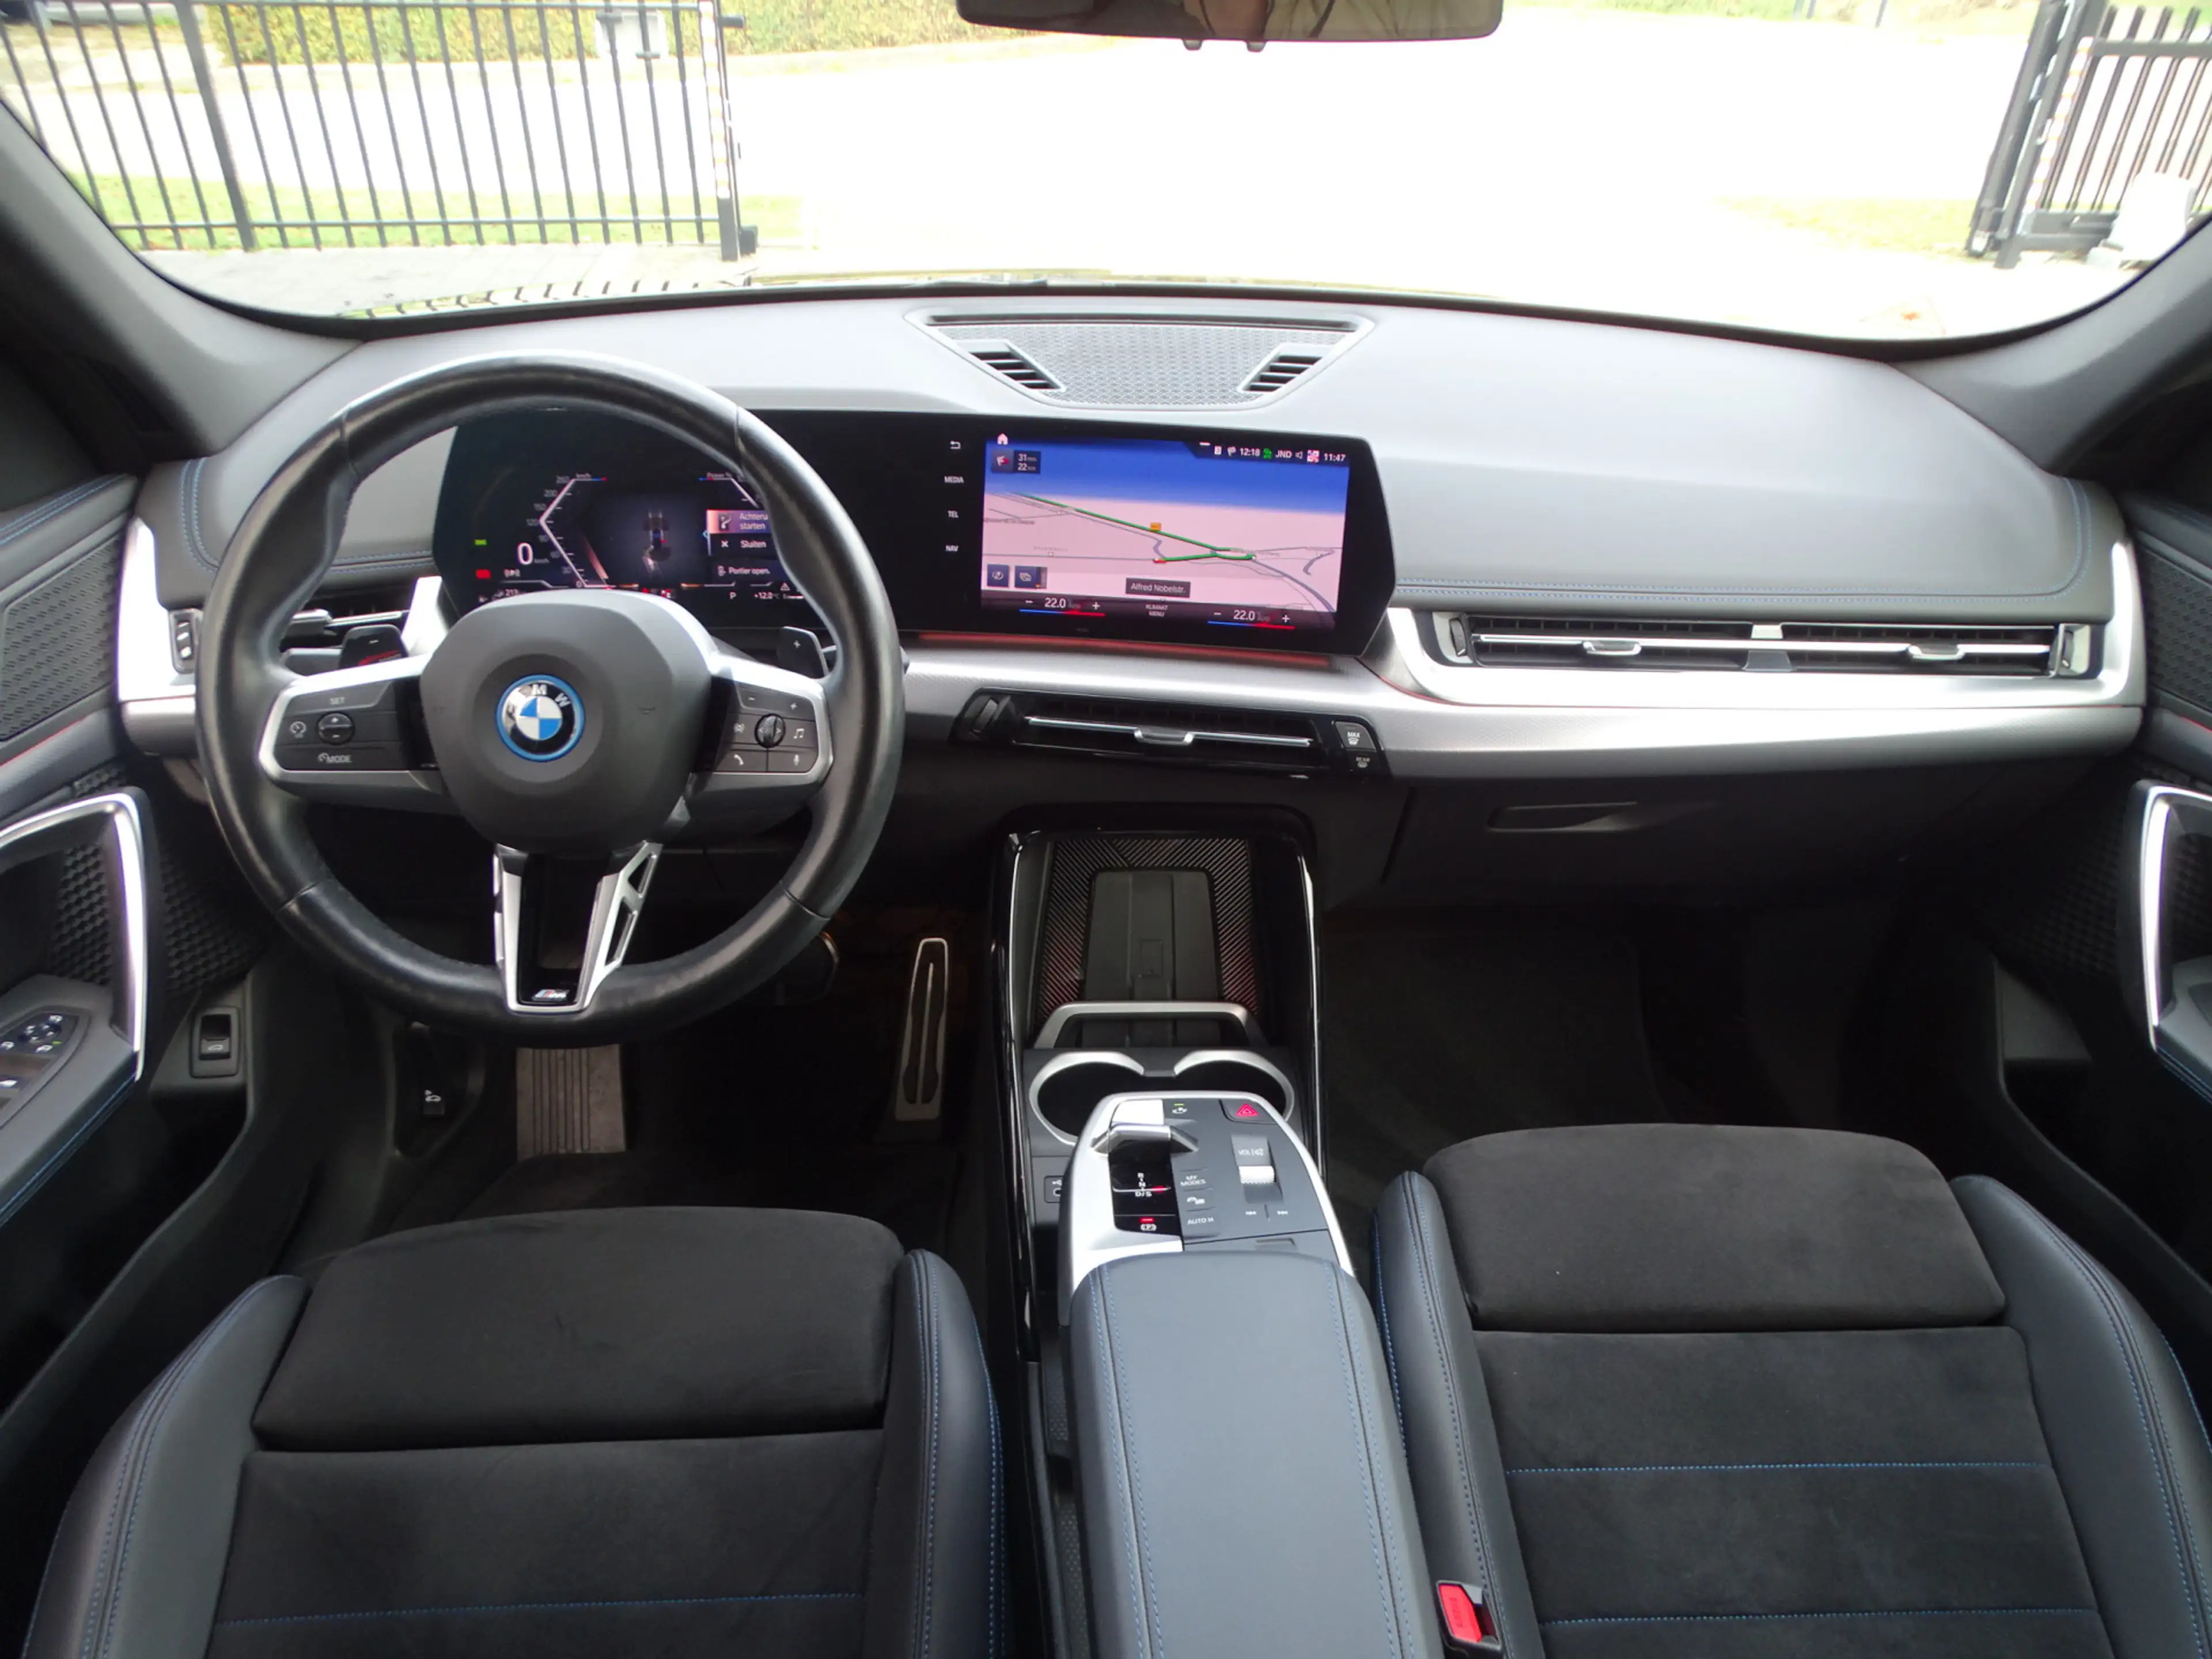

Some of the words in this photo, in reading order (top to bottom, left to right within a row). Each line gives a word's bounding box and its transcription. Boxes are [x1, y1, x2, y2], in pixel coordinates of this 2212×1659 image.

[1018, 453, 1027, 461] 31
[948, 510, 959, 518] TEL
[945, 544, 959, 552] NAV
[517, 542, 533, 565] 0
[1131, 582, 1153, 591] Alfred
[1154, 584, 1185, 593] Nobelstr.
[1044, 597, 1066, 608] 22.0
[1233, 609, 1255, 620] 22.0
[327, 755, 352, 763] MODE
